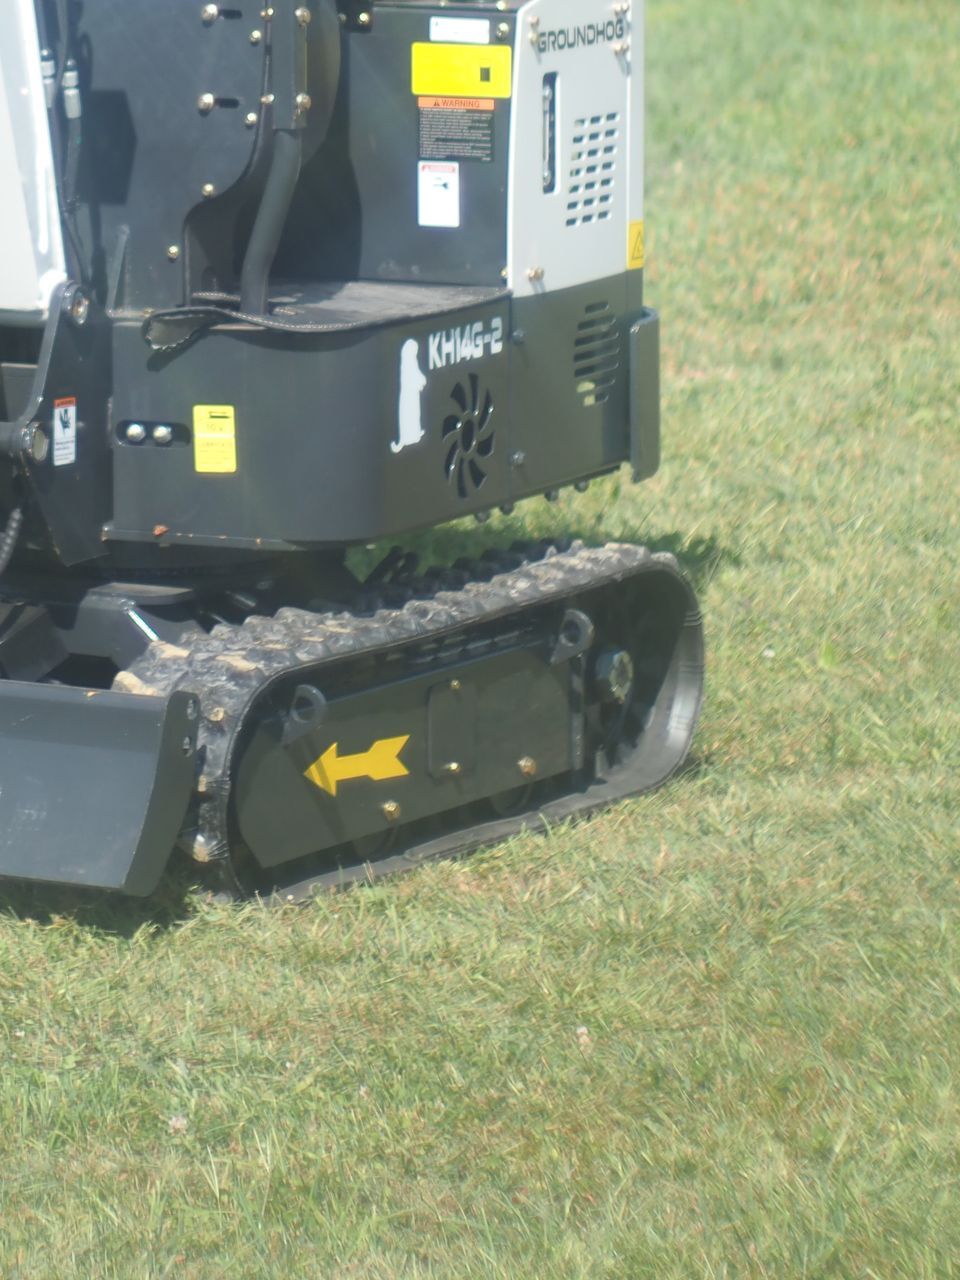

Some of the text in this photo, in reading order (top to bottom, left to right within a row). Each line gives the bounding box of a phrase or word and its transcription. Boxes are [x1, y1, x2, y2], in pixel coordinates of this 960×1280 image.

[537, 18, 624, 53] GROUNDHOG
[441, 99, 481, 108] WARNING
[428, 316, 503, 370] KH14G-2
